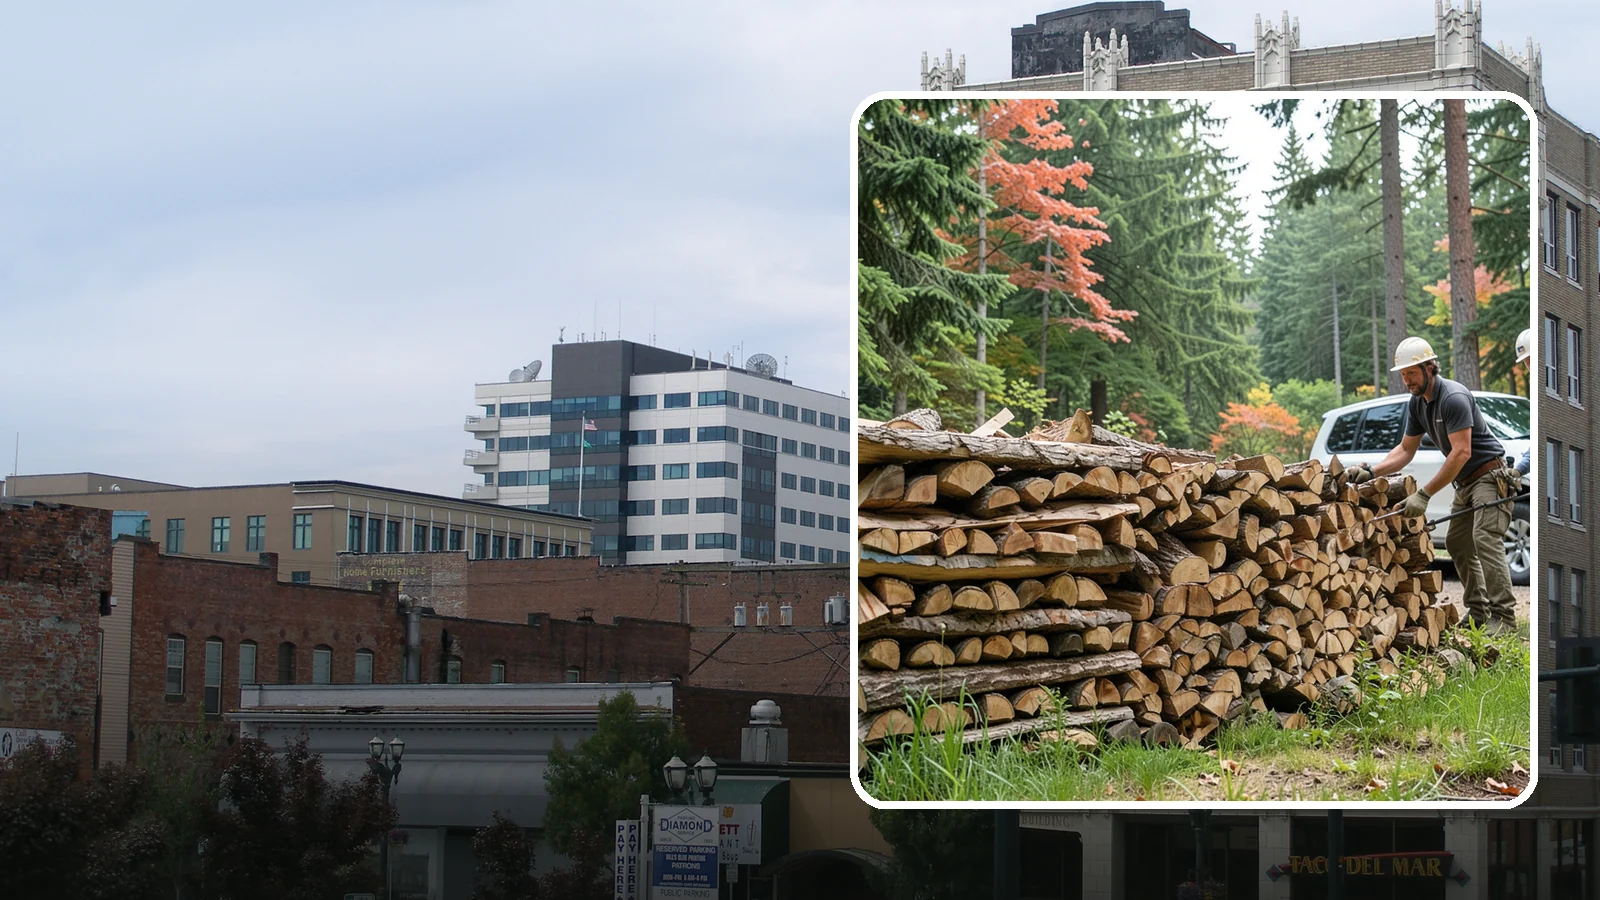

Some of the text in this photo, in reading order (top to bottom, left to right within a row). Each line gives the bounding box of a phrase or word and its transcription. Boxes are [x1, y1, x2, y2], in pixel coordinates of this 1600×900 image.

[370, 566, 427, 576] Furnishers
[660, 818, 713, 833] DIAMOND
[1022, 815, 1070, 828] BUILDING
[719, 824, 740, 835] ETT
[719, 839, 740, 848] ANT
[689, 846, 716, 854] PARKING
[616, 825, 625, 893] PAY HERE
[627, 824, 637, 893] PAY HERE
[721, 852, 739, 862] Soup
[671, 862, 701, 870] PATRONS
[1289, 855, 1442, 877] TAC DEL MAR
[660, 888, 710, 898] PUBLIC PARKING
